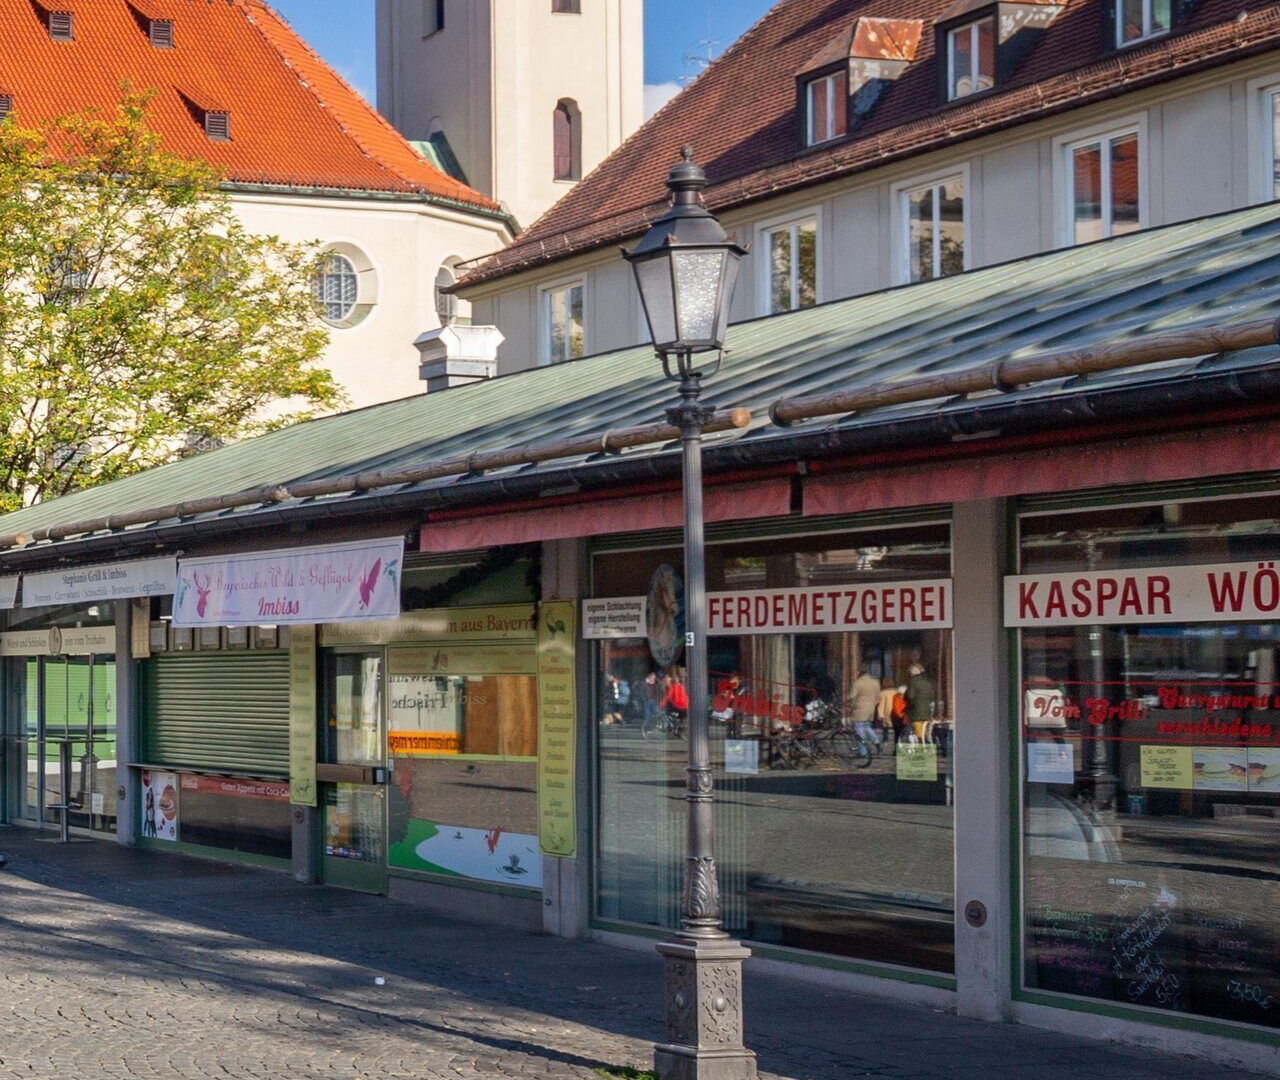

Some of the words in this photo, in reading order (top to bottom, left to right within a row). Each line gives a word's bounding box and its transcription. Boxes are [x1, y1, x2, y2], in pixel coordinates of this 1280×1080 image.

[1019, 575, 1172, 619] KASPAR
[1207, 562, 1280, 613] WÖ
[258, 597, 299, 616] Imbiss
[709, 586, 945, 628] FERDEMETZGEREI
[460, 620, 483, 632] aus
[1034, 695, 1080, 718] Vom
[266, 787, 289, 797] Coca-Co
